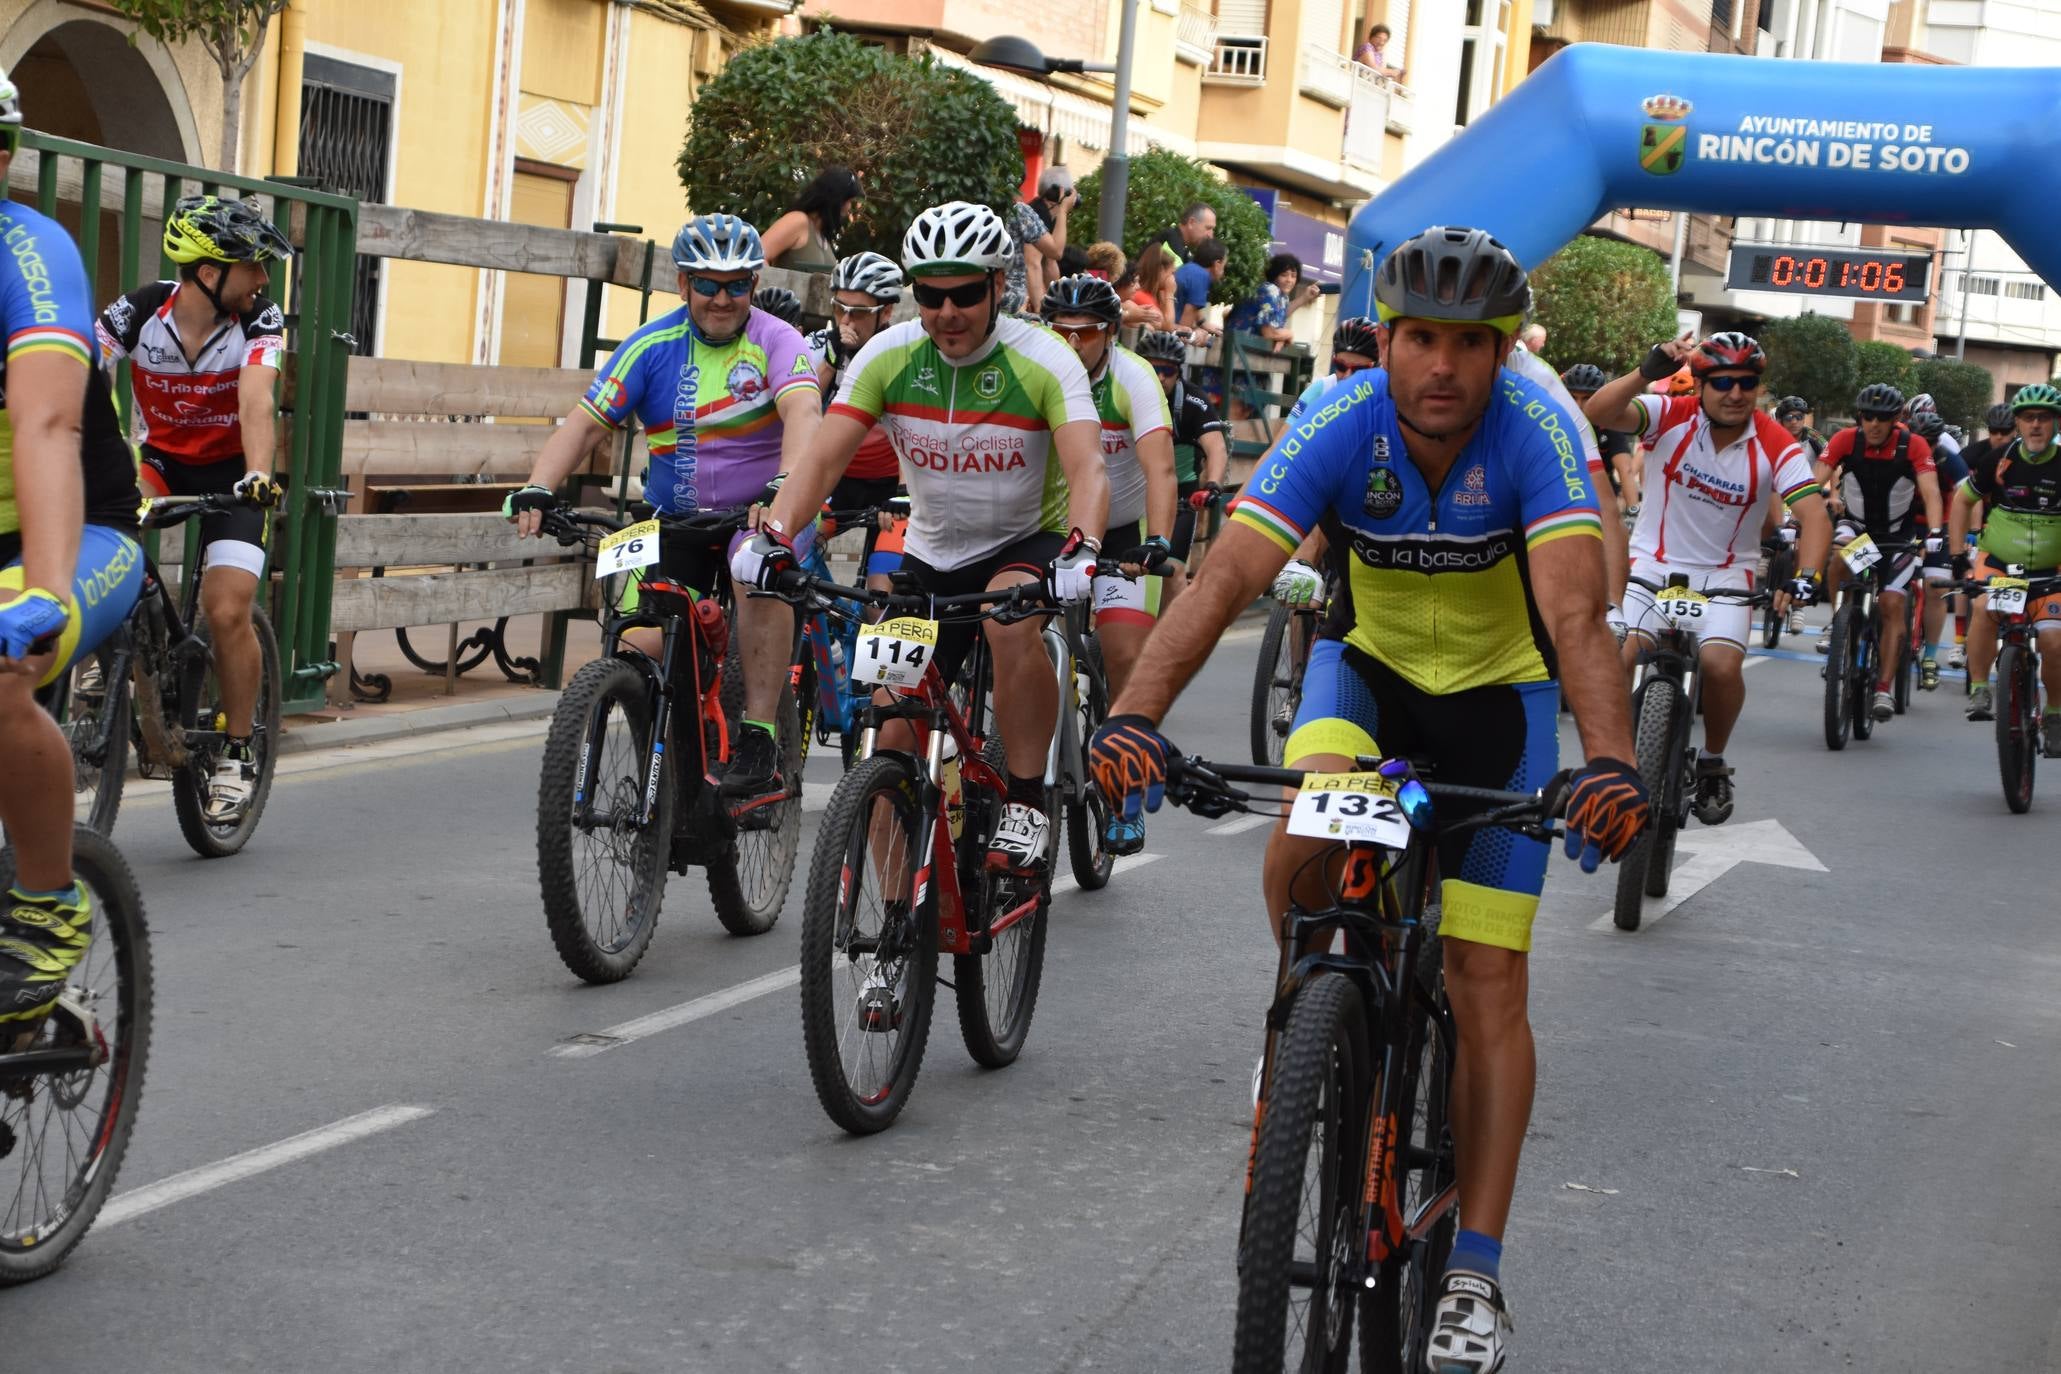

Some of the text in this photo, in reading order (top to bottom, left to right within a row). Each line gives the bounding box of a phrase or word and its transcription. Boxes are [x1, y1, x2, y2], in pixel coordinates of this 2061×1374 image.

[1739, 115, 1932, 142] AYUNTAMIENTO DE
[1698, 133, 1970, 174] RINCÓN DE SOTO
[12, 236, 60, 323] bascula
[1771, 255, 1904, 292] 0:01:06
[891, 417, 1024, 452] Sociedad Ciclista
[1280, 437, 1302, 461] la
[1297, 381, 1374, 440] bascula
[1540, 413, 1586, 500] bascula
[1683, 463, 1745, 492] CHATARRAS
[673, 484, 699, 512] OS
[622, 524, 655, 540] PERA
[612, 539, 643, 558] 76
[1392, 548, 1411, 564] la
[1419, 541, 1507, 568] bascula
[1662, 600, 1702, 617] 155
[890, 623, 932, 640] PERA
[867, 637, 925, 668] 114
[1308, 780, 1340, 790] LA
[1311, 793, 1401, 824] 132
